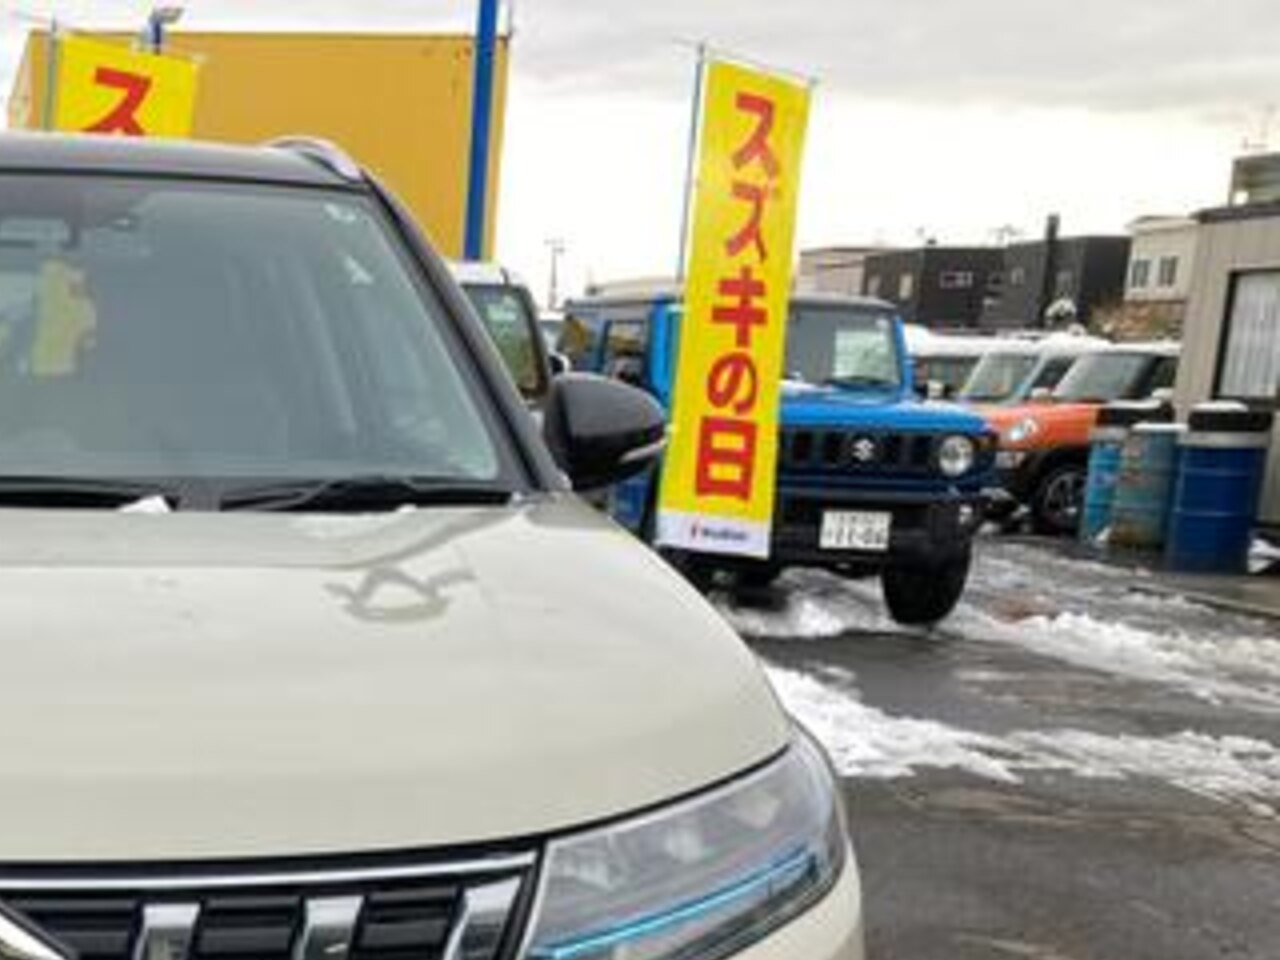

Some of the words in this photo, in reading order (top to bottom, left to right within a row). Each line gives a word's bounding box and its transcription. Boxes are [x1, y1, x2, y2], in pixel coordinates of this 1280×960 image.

[694, 92, 782, 501] スズキの日
